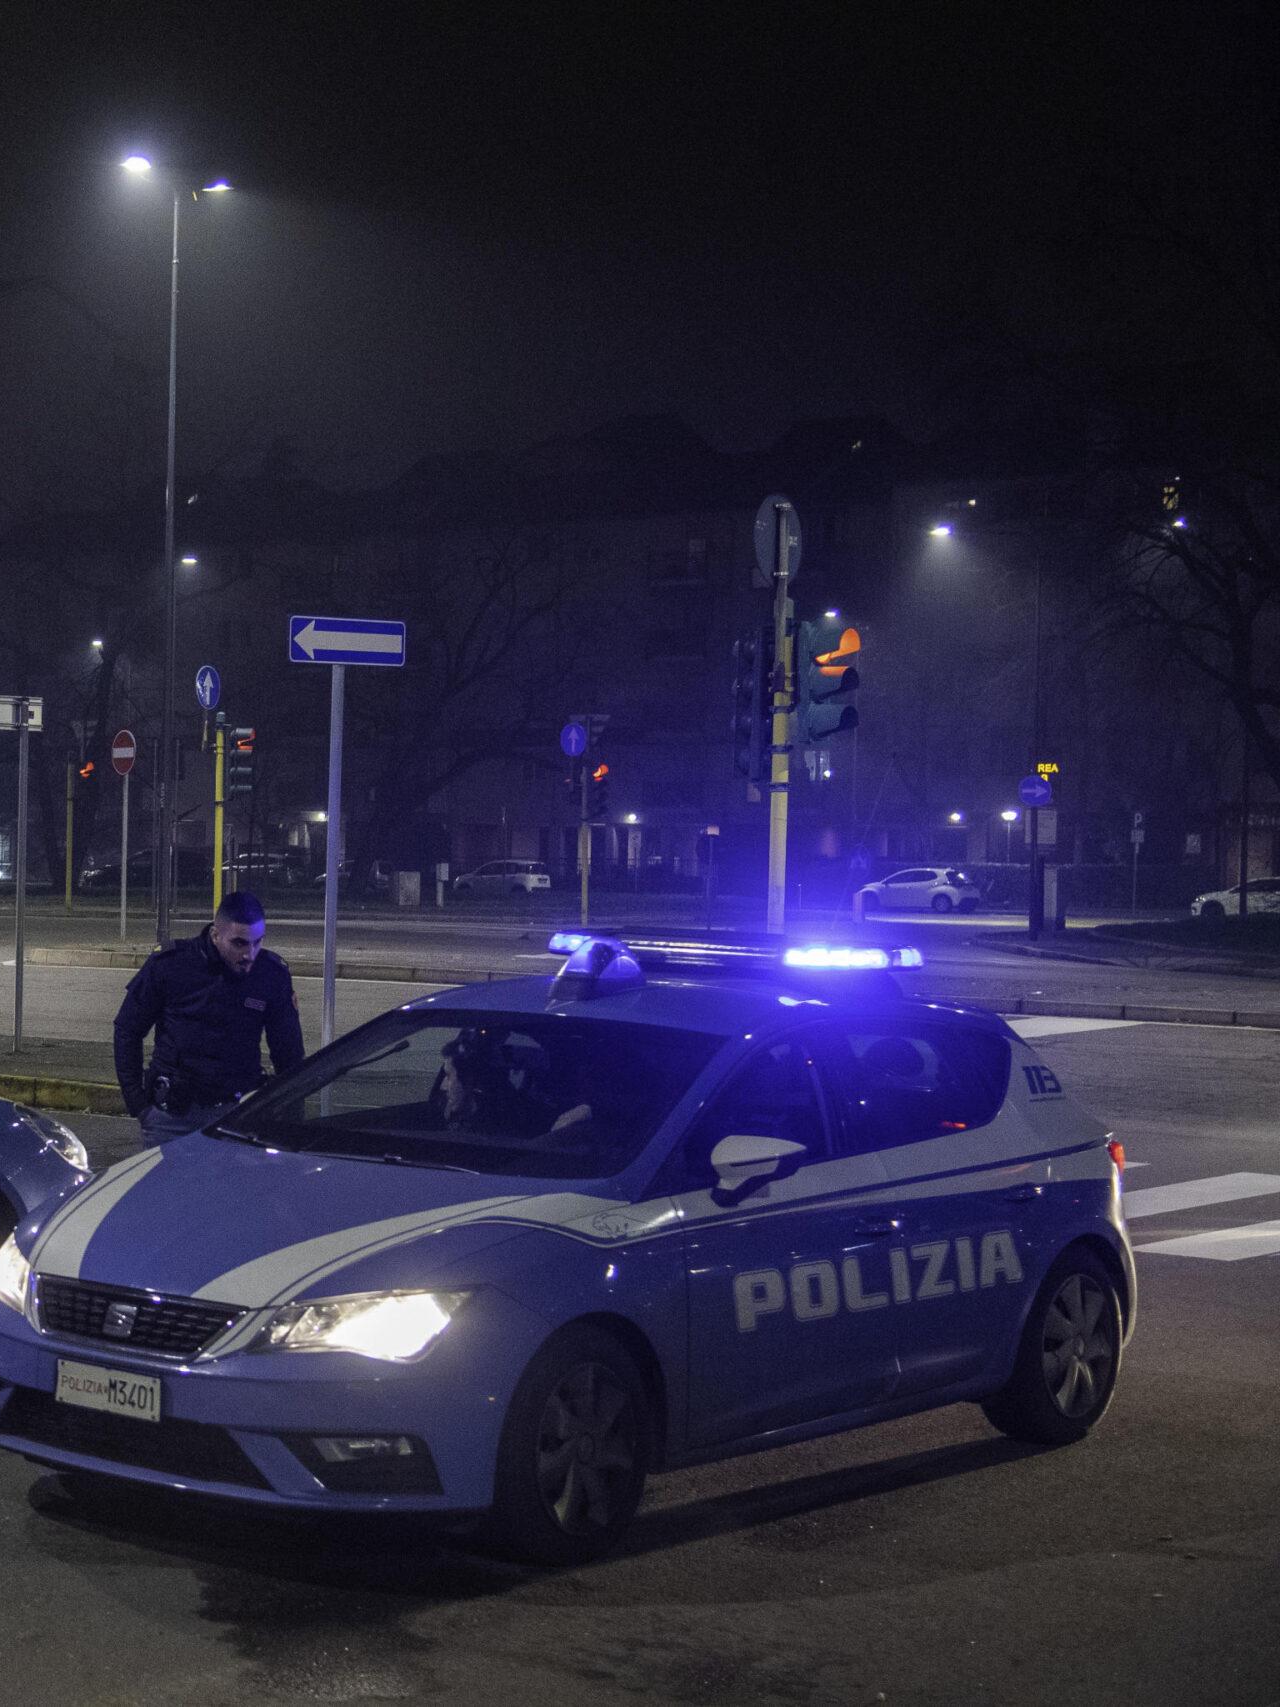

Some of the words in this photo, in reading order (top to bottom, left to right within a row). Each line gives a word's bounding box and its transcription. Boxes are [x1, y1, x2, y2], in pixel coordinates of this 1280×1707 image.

[1021, 1065, 1062, 1094] 113
[732, 1229, 1024, 1333] POLIZIA
[61, 1374, 104, 1395] POLIZIA
[107, 1377, 155, 1412] M3401
